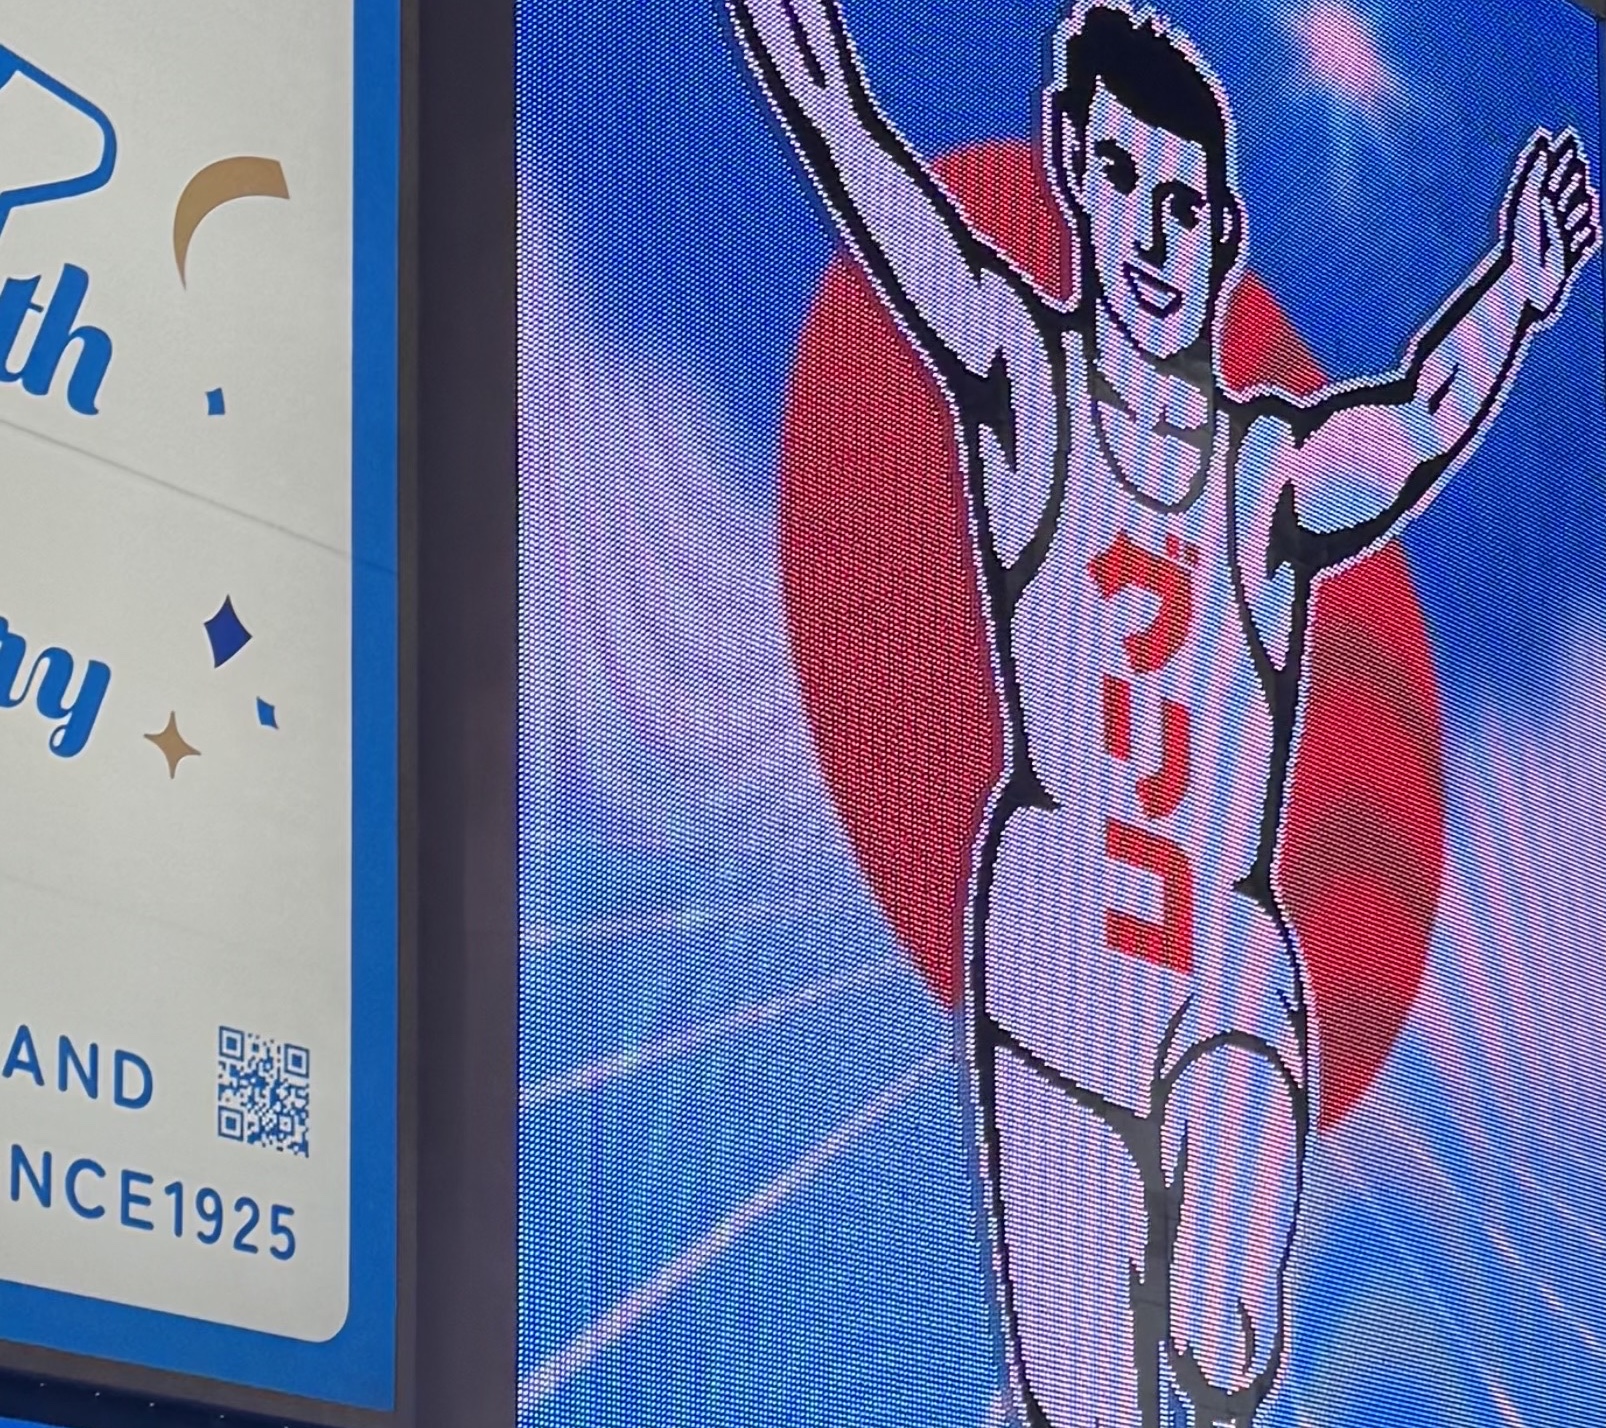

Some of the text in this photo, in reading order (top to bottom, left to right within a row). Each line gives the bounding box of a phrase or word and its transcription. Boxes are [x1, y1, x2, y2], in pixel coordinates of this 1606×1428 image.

[1087, 529, 1200, 976] グリコ
[2, 1024, 154, 1110] AND
[10, 1143, 297, 1261] NCE1925
